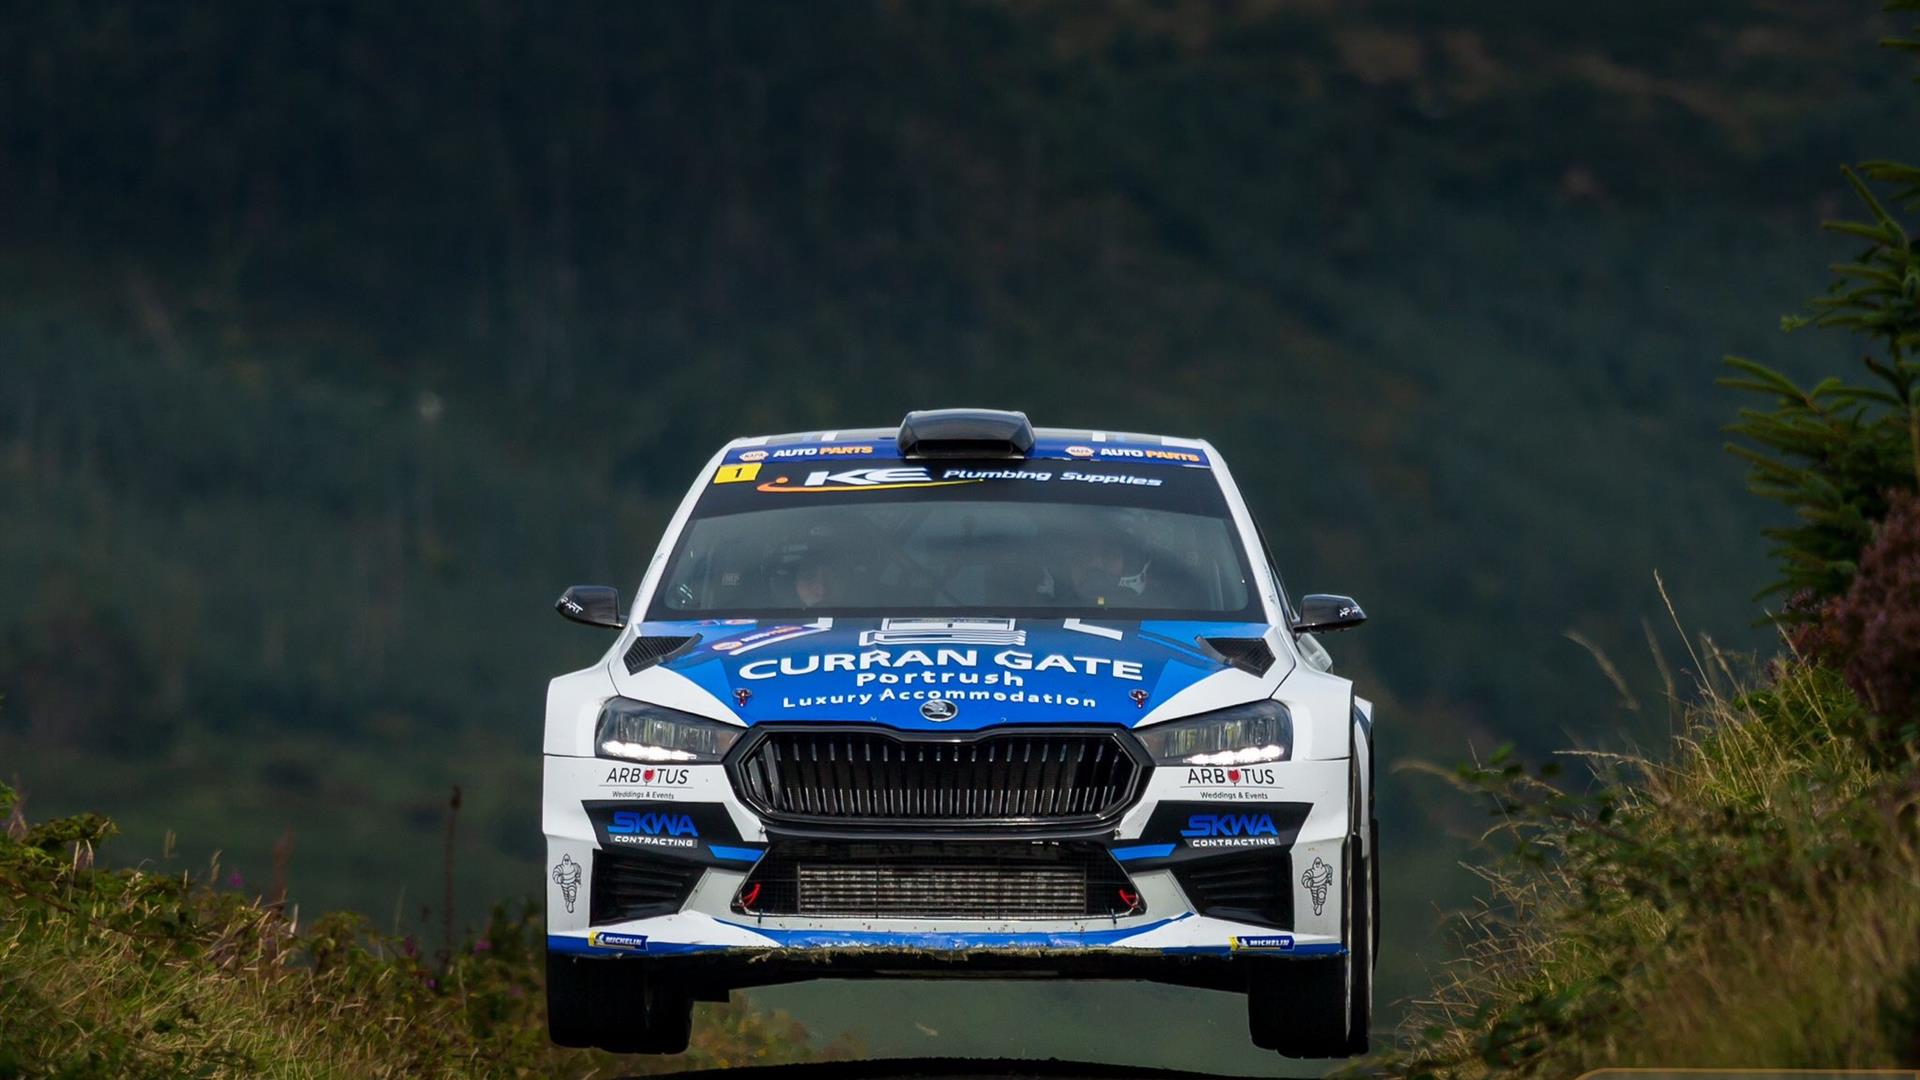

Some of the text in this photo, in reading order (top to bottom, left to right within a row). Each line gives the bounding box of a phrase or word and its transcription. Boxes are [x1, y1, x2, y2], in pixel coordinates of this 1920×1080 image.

[773, 448, 818, 458] AUTO
[819, 446, 873, 456] PARTS
[1100, 447, 1144, 458] AUTO
[1145, 450, 1200, 462] PARTS
[734, 467, 743, 478] 1
[804, 467, 1163, 487] KE Plumbing Supplies
[738, 649, 1143, 681] CURRAN GATE
[856, 671, 1024, 687] Portrush
[783, 688, 1096, 708] Luxury Accommodation
[612, 790, 644, 799] Weddings
[652, 791, 675, 800] Events
[1200, 791, 1237, 800] Weddings
[1245, 791, 1269, 800] Events
[607, 811, 699, 838] SKWA
[1180, 814, 1279, 837] SKWA
[614, 835, 694, 847] CONTRACTING
[1192, 837, 1276, 848] CONTRACTING
[605, 936, 643, 946] MICHELIN
[1249, 938, 1290, 947] MICHELIN
